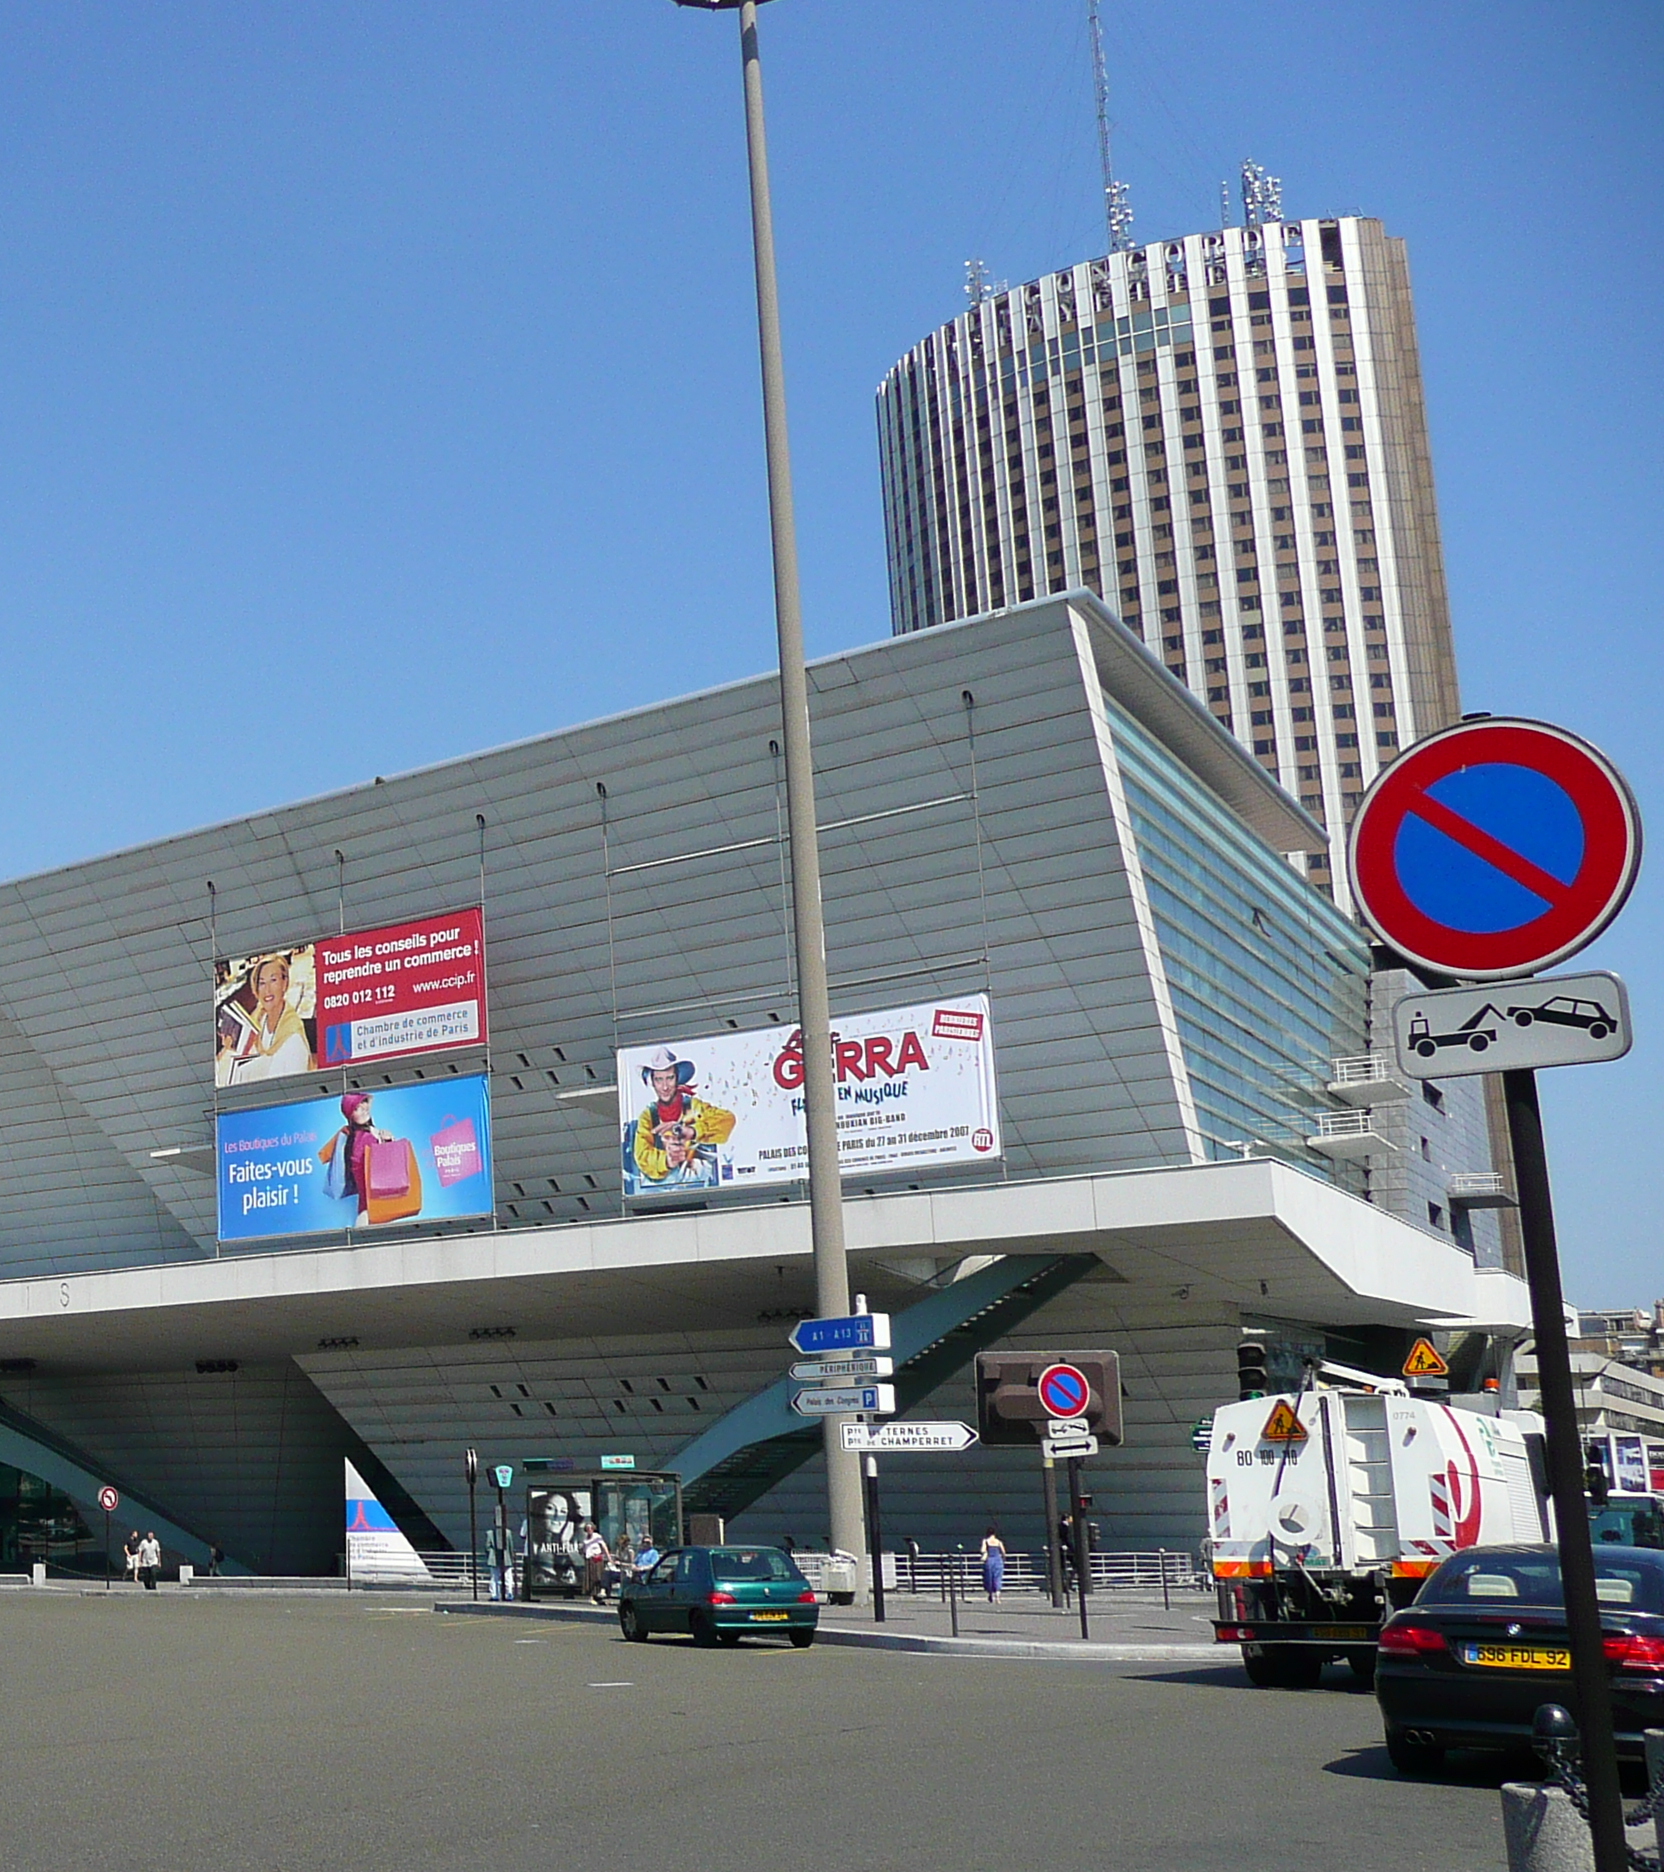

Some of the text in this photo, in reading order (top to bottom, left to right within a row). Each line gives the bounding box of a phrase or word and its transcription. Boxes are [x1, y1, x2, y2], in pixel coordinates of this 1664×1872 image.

[322, 927, 461, 965] Tous les conseils pour
[323, 961, 382, 985] reprendre
[385, 959, 401, 973] un
[404, 944, 471, 968] commerce
[412, 970, 476, 994] www.ccip.fr
[324, 992, 350, 1010] 0820
[352, 989, 372, 1004] 012
[374, 984, 396, 1000] 112
[356, 1009, 468, 1037] Chambre de commerce
[357, 1038, 367, 1051] et
[426, 1026, 439, 1038] de
[441, 1022, 469, 1036] Paris
[772, 1031, 930, 1090] GRRA
[854, 1080, 909, 1105] MUSIQUE
[224, 1131, 318, 1154] Les Boutiques du Palais
[434, 1141, 476, 1157] Boutiques
[842, 1139, 864, 1151] PARIS
[865, 1136, 876, 1148] du
[876, 1135, 886, 1147] 27
[887, 1135, 897, 1146] au
[897, 1133, 907, 1144] 31
[908, 1127, 949, 1142] décembre
[949, 1125, 970, 1138] 2007
[437, 1154, 461, 1168] Palais
[758, 1147, 782, 1161] PALAIS
[783, 1146, 797, 1157] DES
[229, 1158, 313, 1184] Faites-vous
[243, 1184, 289, 1216] plaisir
[1393, 1411, 1416, 1420] 0774
[881, 1437, 953, 1446] CHAMPERRET
[886, 1427, 929, 1436] TERNES
[1236, 1450, 1253, 1467] 80
[1260, 1450, 1275, 1465] 100
[1477, 1646, 1567, 1666] 696 FDL 92
